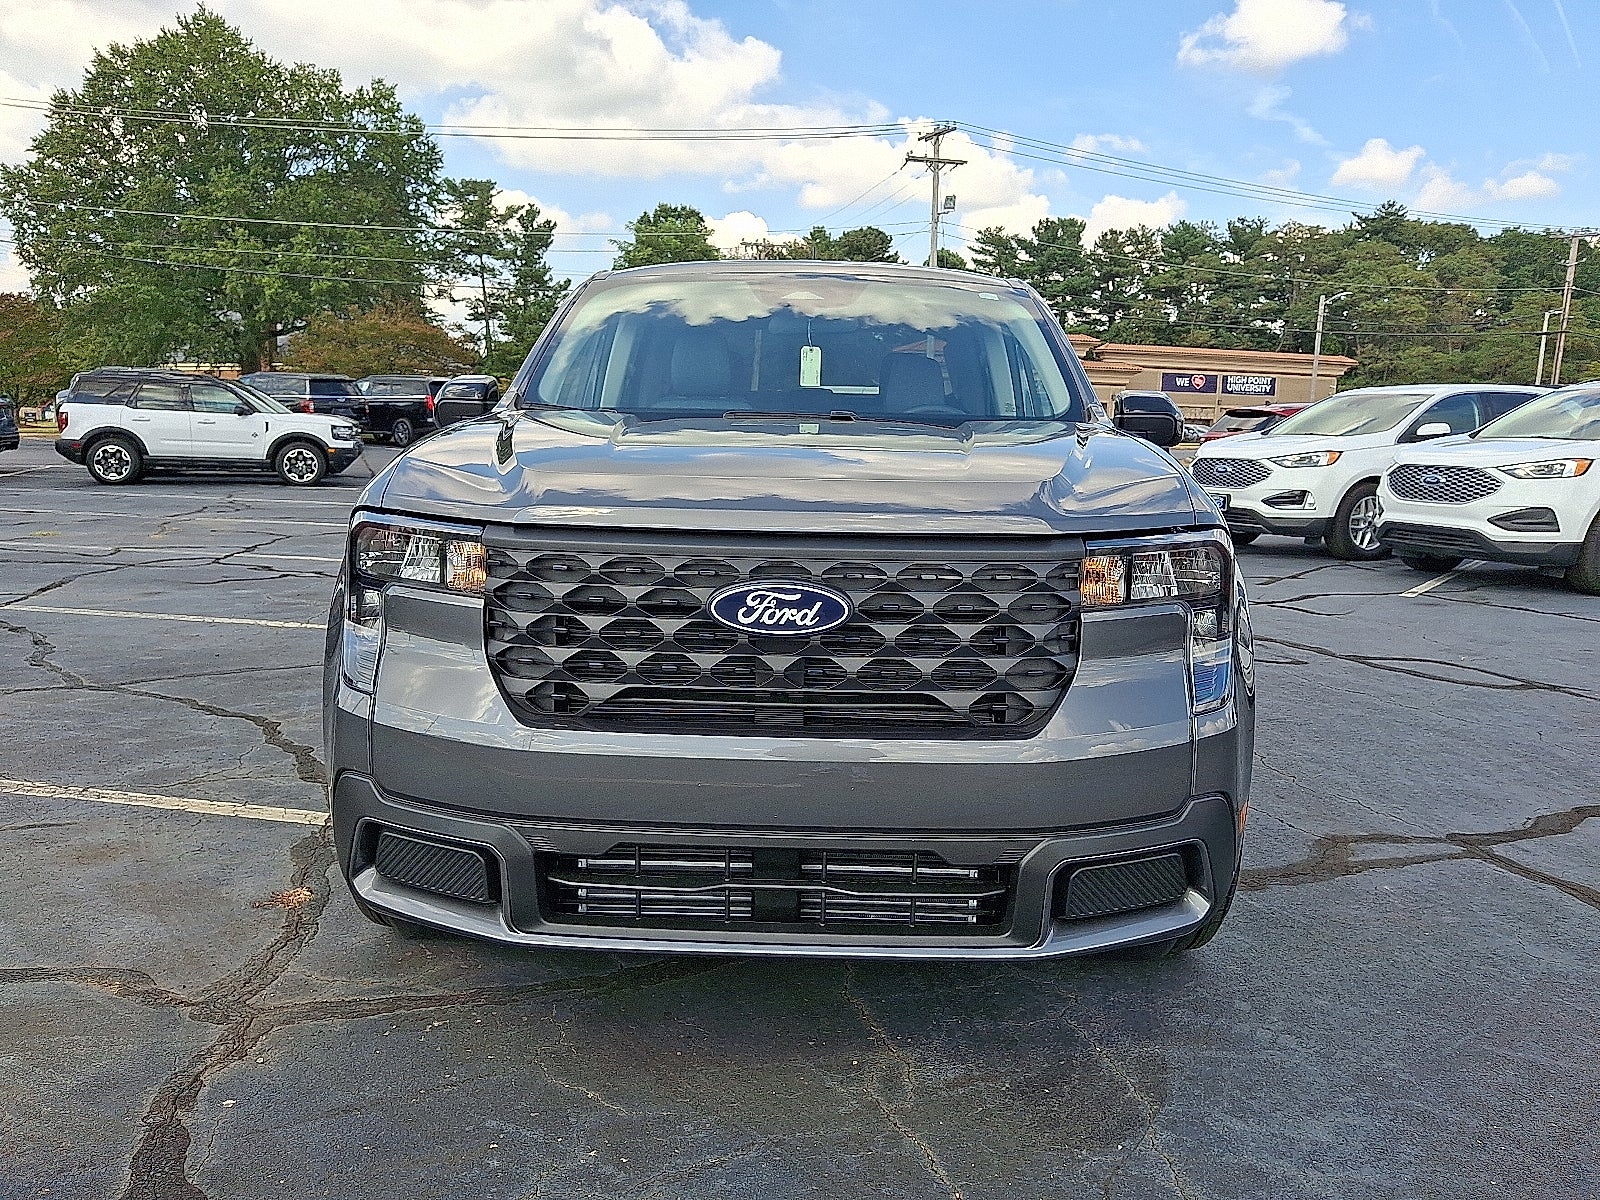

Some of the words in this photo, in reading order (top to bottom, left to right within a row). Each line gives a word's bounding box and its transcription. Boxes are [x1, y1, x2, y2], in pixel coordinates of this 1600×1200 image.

[1176, 377, 1190, 387] WE
[1228, 375, 1247, 384] HIGH
[1248, 376, 1272, 385] POINT
[1226, 383, 1272, 393] UNIVERSITY
[737, 590, 823, 626] Ford
